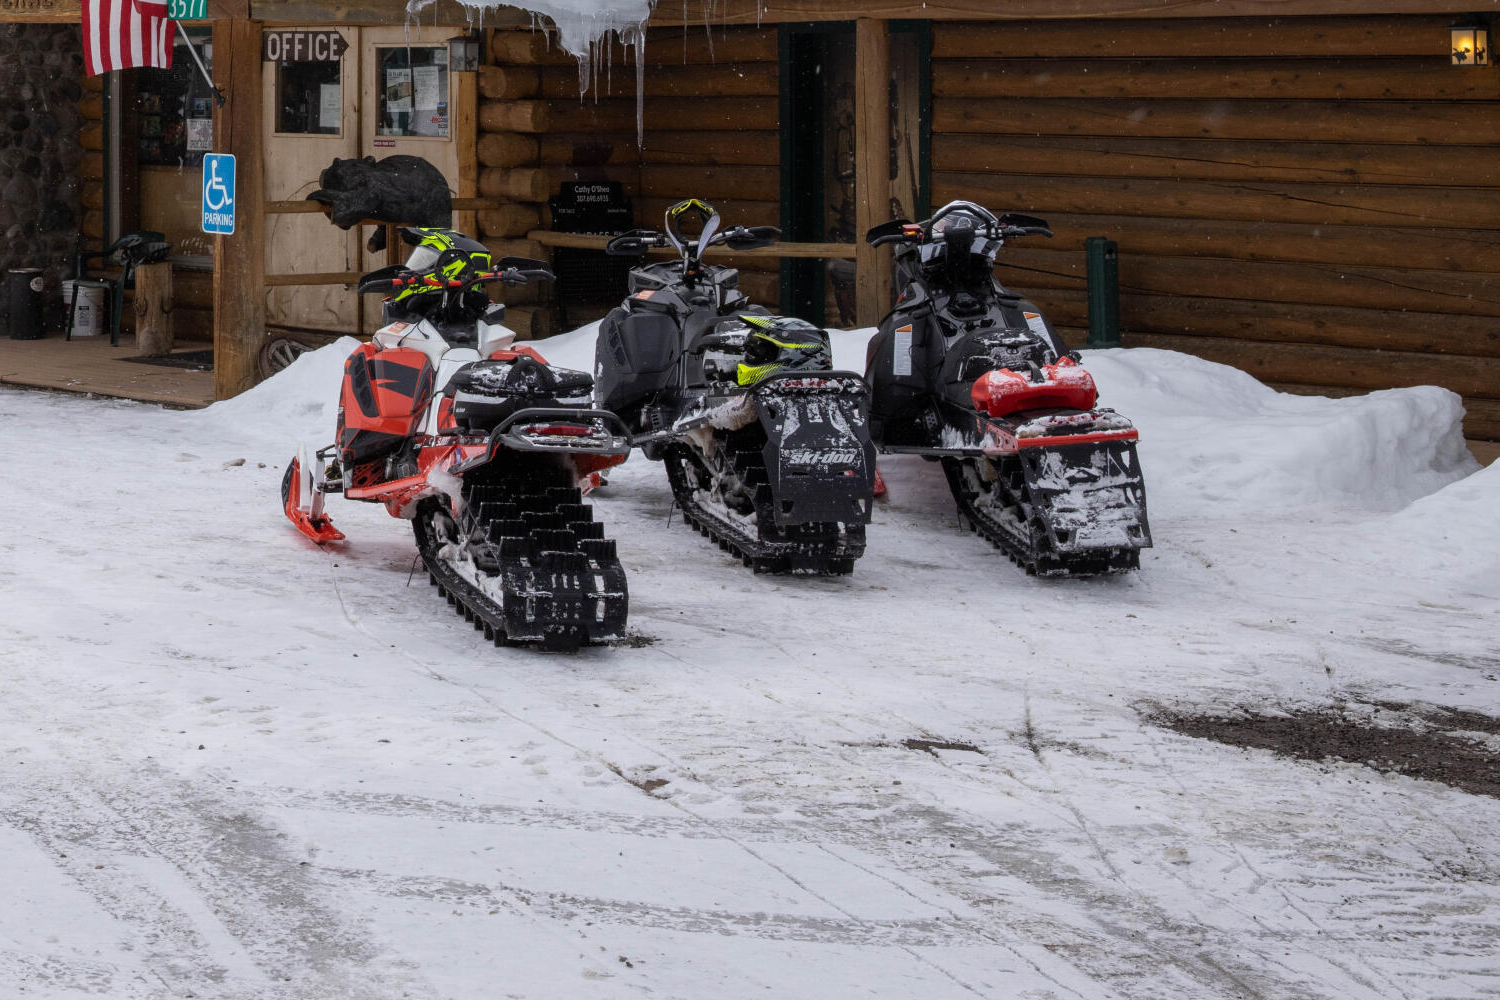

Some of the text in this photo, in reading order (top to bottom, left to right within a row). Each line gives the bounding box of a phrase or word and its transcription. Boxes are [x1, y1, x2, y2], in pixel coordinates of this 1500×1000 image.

[267, 33, 340, 61] OFFICE
[575, 185, 610, 194] Cathy O'Shea
[204, 212, 233, 226] PARKING
[790, 451, 856, 464] ski-doo
